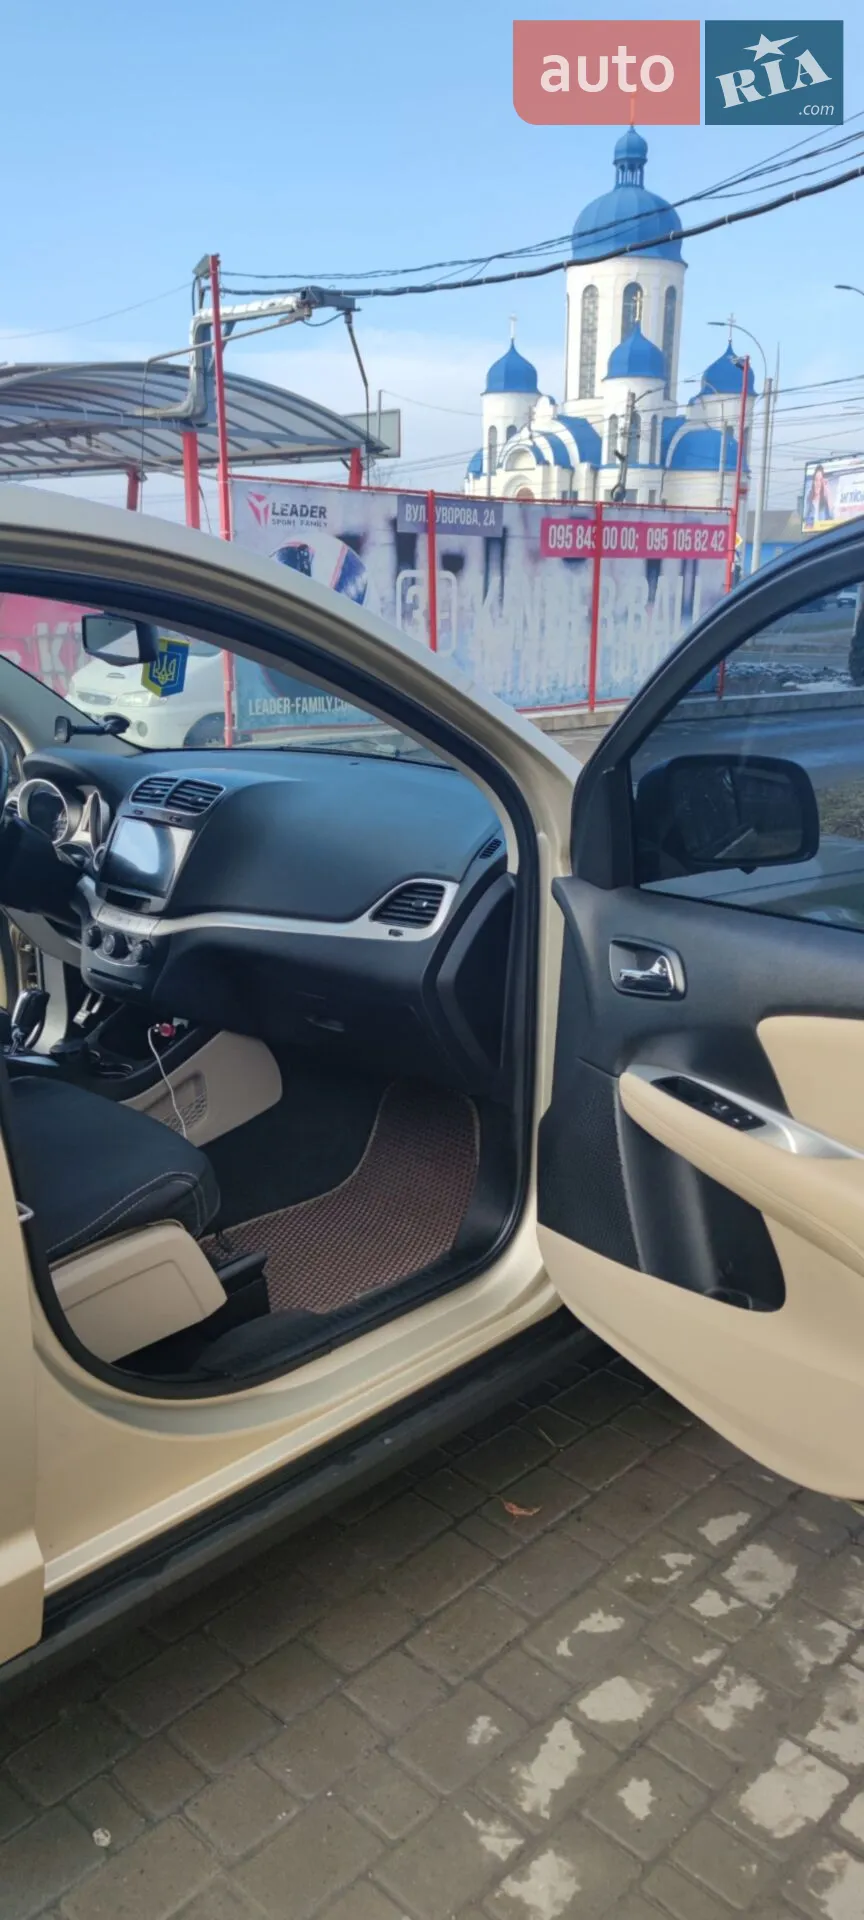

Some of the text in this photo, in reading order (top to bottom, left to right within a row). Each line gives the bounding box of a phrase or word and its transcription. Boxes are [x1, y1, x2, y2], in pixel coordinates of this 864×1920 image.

[271, 502, 327, 519] LEADER
[430, 506, 481, 527] УВОРОВА,
[548, 524, 573, 549] 095
[602, 526, 618, 550] 00
[646, 527, 669, 550] 095
[672, 528, 692, 551] 105
[694, 529, 709, 552] 82
[710, 530, 725, 552] 42
[248, 696, 350, 716] LEADER-FAMILY.CO
